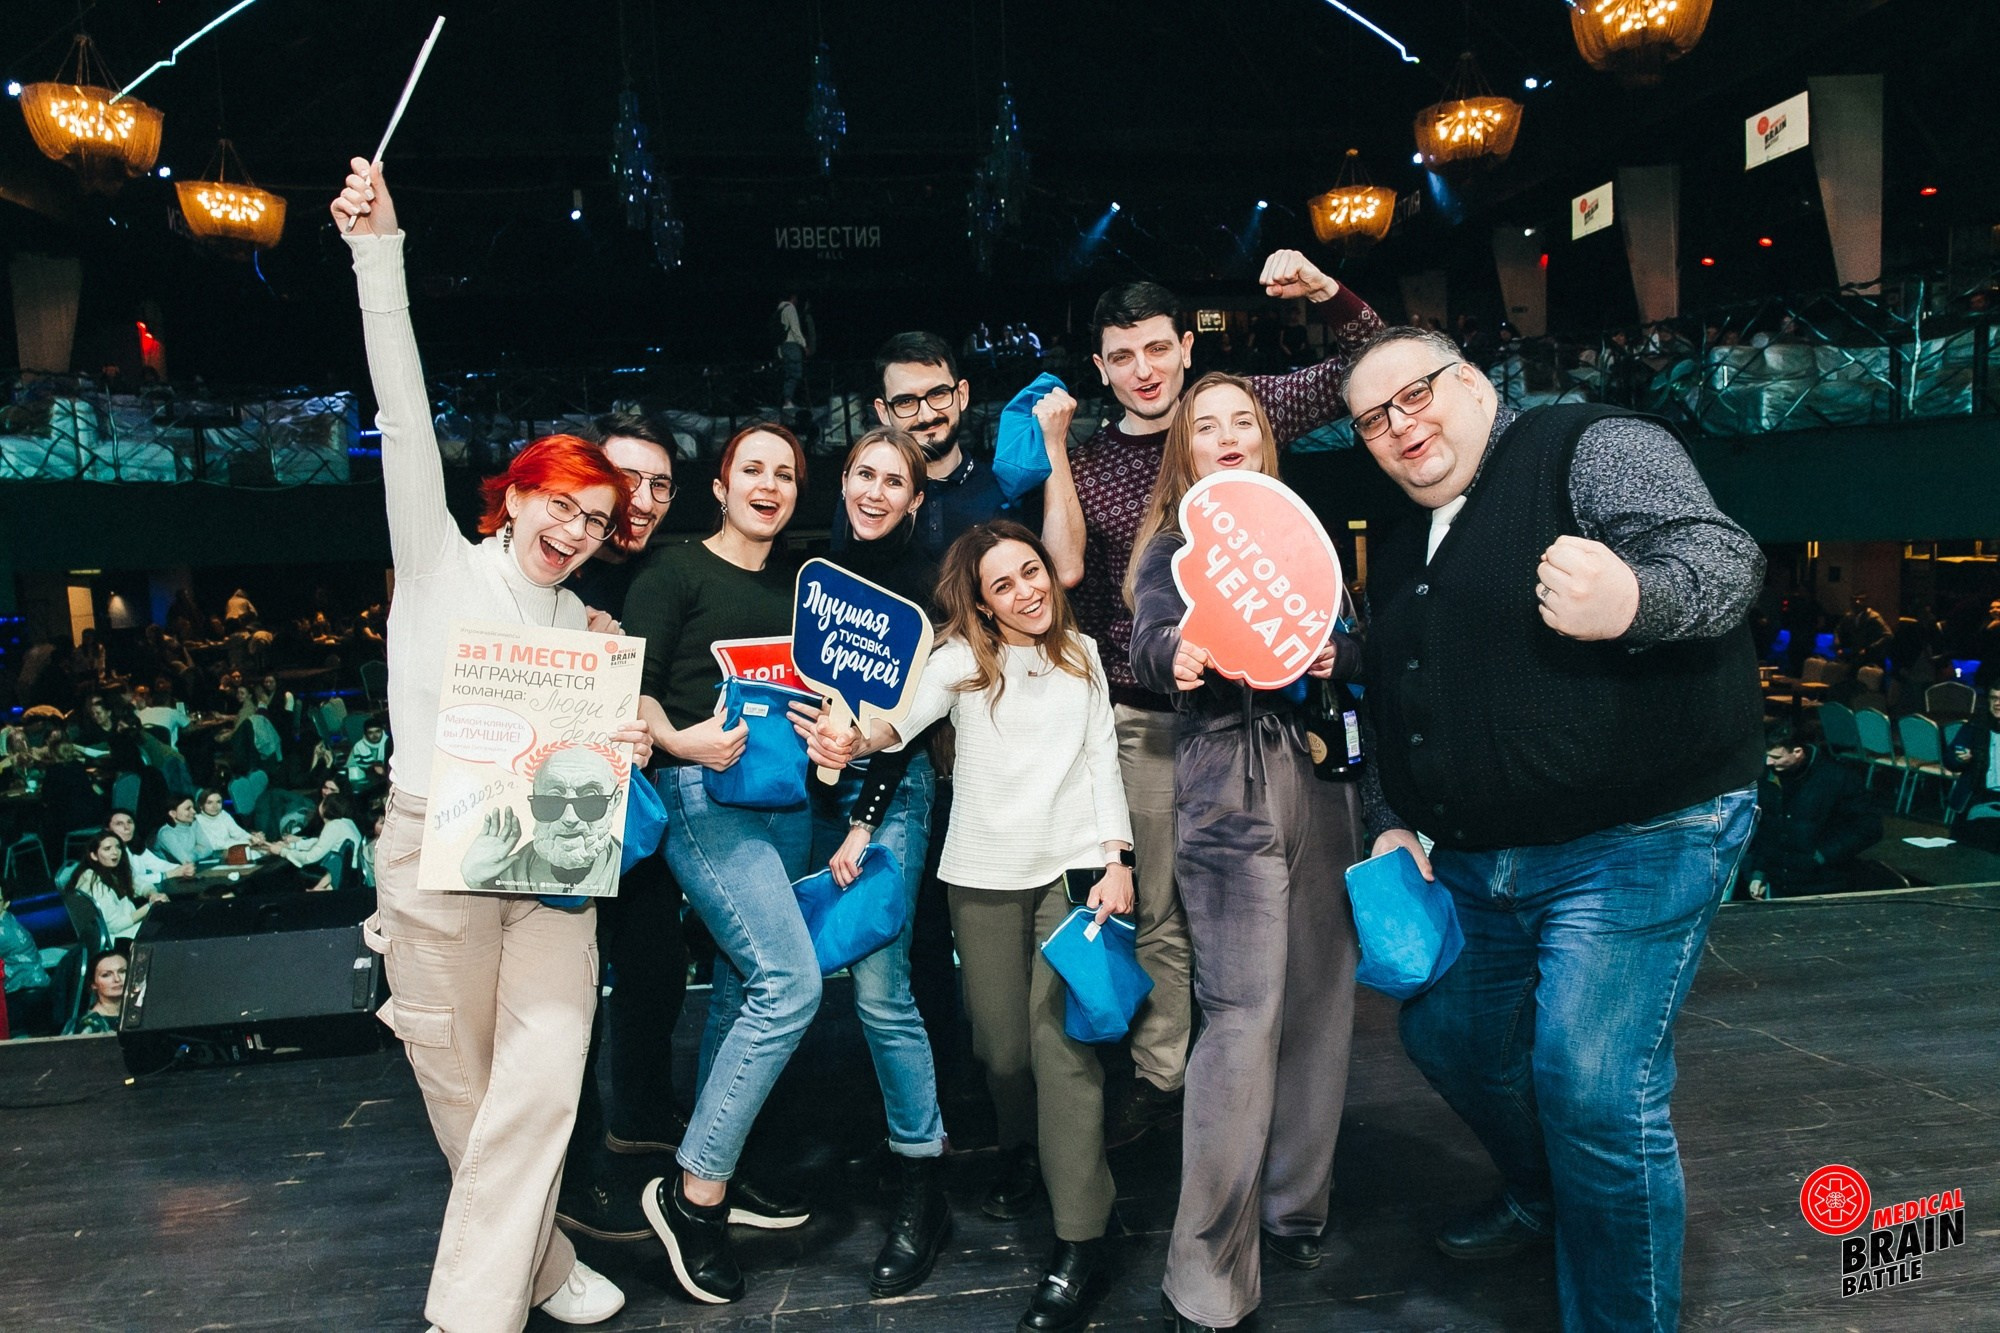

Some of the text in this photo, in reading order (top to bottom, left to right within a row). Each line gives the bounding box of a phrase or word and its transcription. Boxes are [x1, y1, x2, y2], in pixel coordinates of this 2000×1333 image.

[775, 226, 881, 249] ИЗВЕСТИЯ
[1193, 489, 1329, 638] МОЗГОВОЙ
[803, 581, 891, 640] Лучшая
[1204, 544, 1312, 670] ЧЕКАП
[457, 643, 598, 672] за 1 МЕСТО
[611, 652, 637, 661] BRAIN
[839, 628, 891, 659] ТУСОВКА
[821, 631, 900, 689] врачей
[454, 663, 596, 691] НАГРАЖДАЕТСЯ
[452, 684, 527, 702] команда:
[459, 727, 521, 743] ЛУЧШИЕ!
